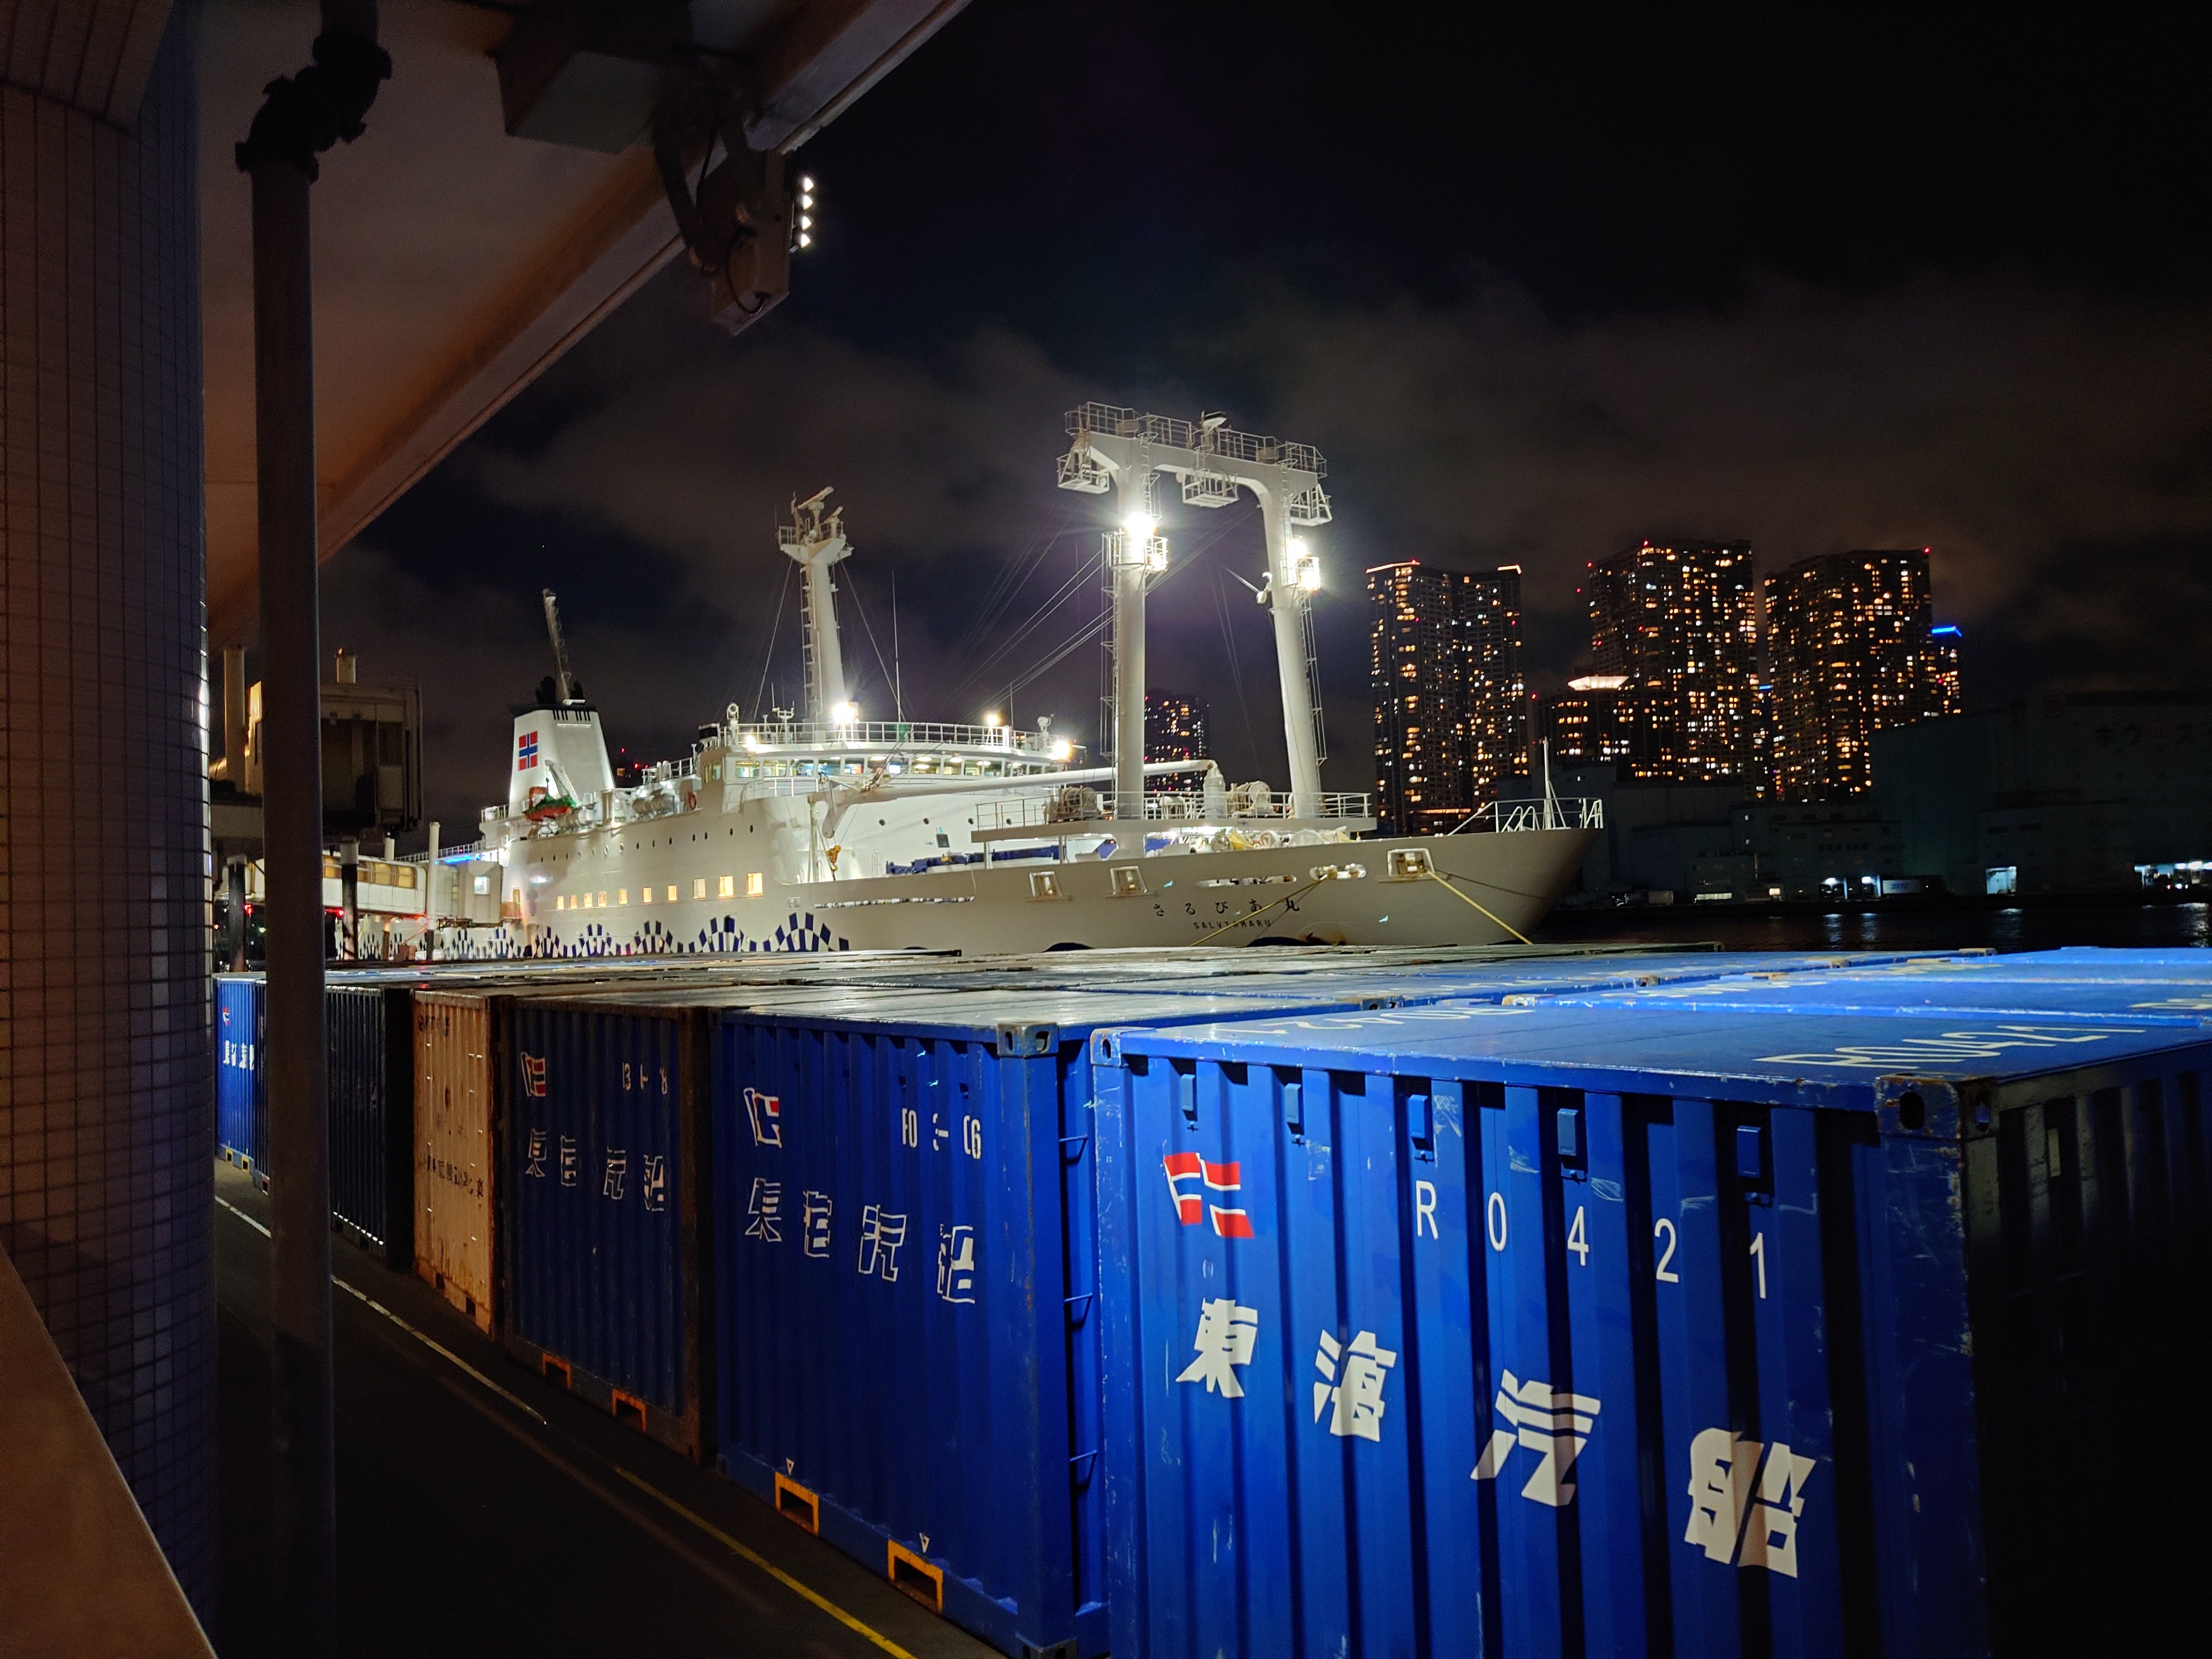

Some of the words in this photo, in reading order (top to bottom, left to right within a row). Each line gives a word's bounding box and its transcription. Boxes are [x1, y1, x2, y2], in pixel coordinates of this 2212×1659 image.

[1153, 898, 1300, 917] さるびあ丸
[1415, 1180, 1766, 1299] R0421
[1176, 1297, 1816, 1578] 東海汽船
